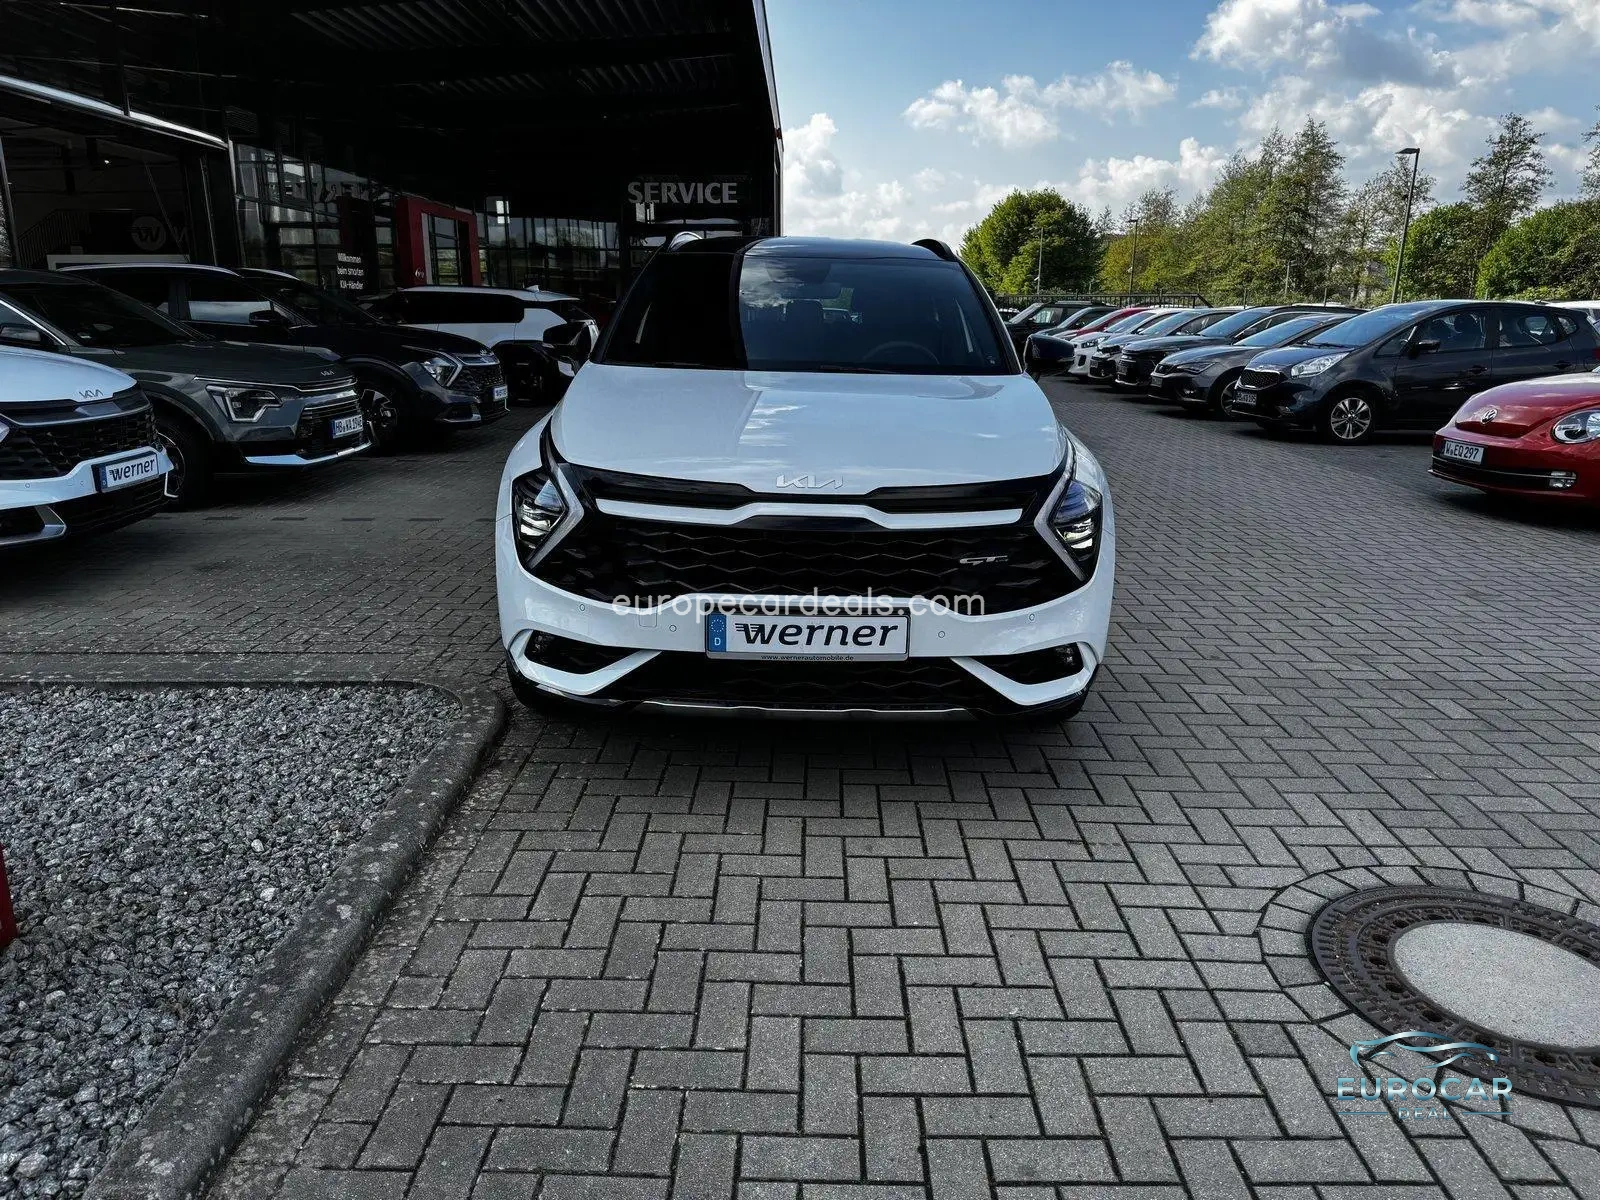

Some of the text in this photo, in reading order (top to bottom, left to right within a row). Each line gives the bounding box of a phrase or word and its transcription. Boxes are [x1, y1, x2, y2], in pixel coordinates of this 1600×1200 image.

[627, 181, 738, 204] SERVICE
[1464, 446, 1479, 460] 297
[109, 458, 155, 482] werner
[776, 475, 844, 490] KIA
[714, 637, 722, 647] D
[735, 622, 899, 647] werner
[761, 654, 854, 662] www.wernerautomobile.de
